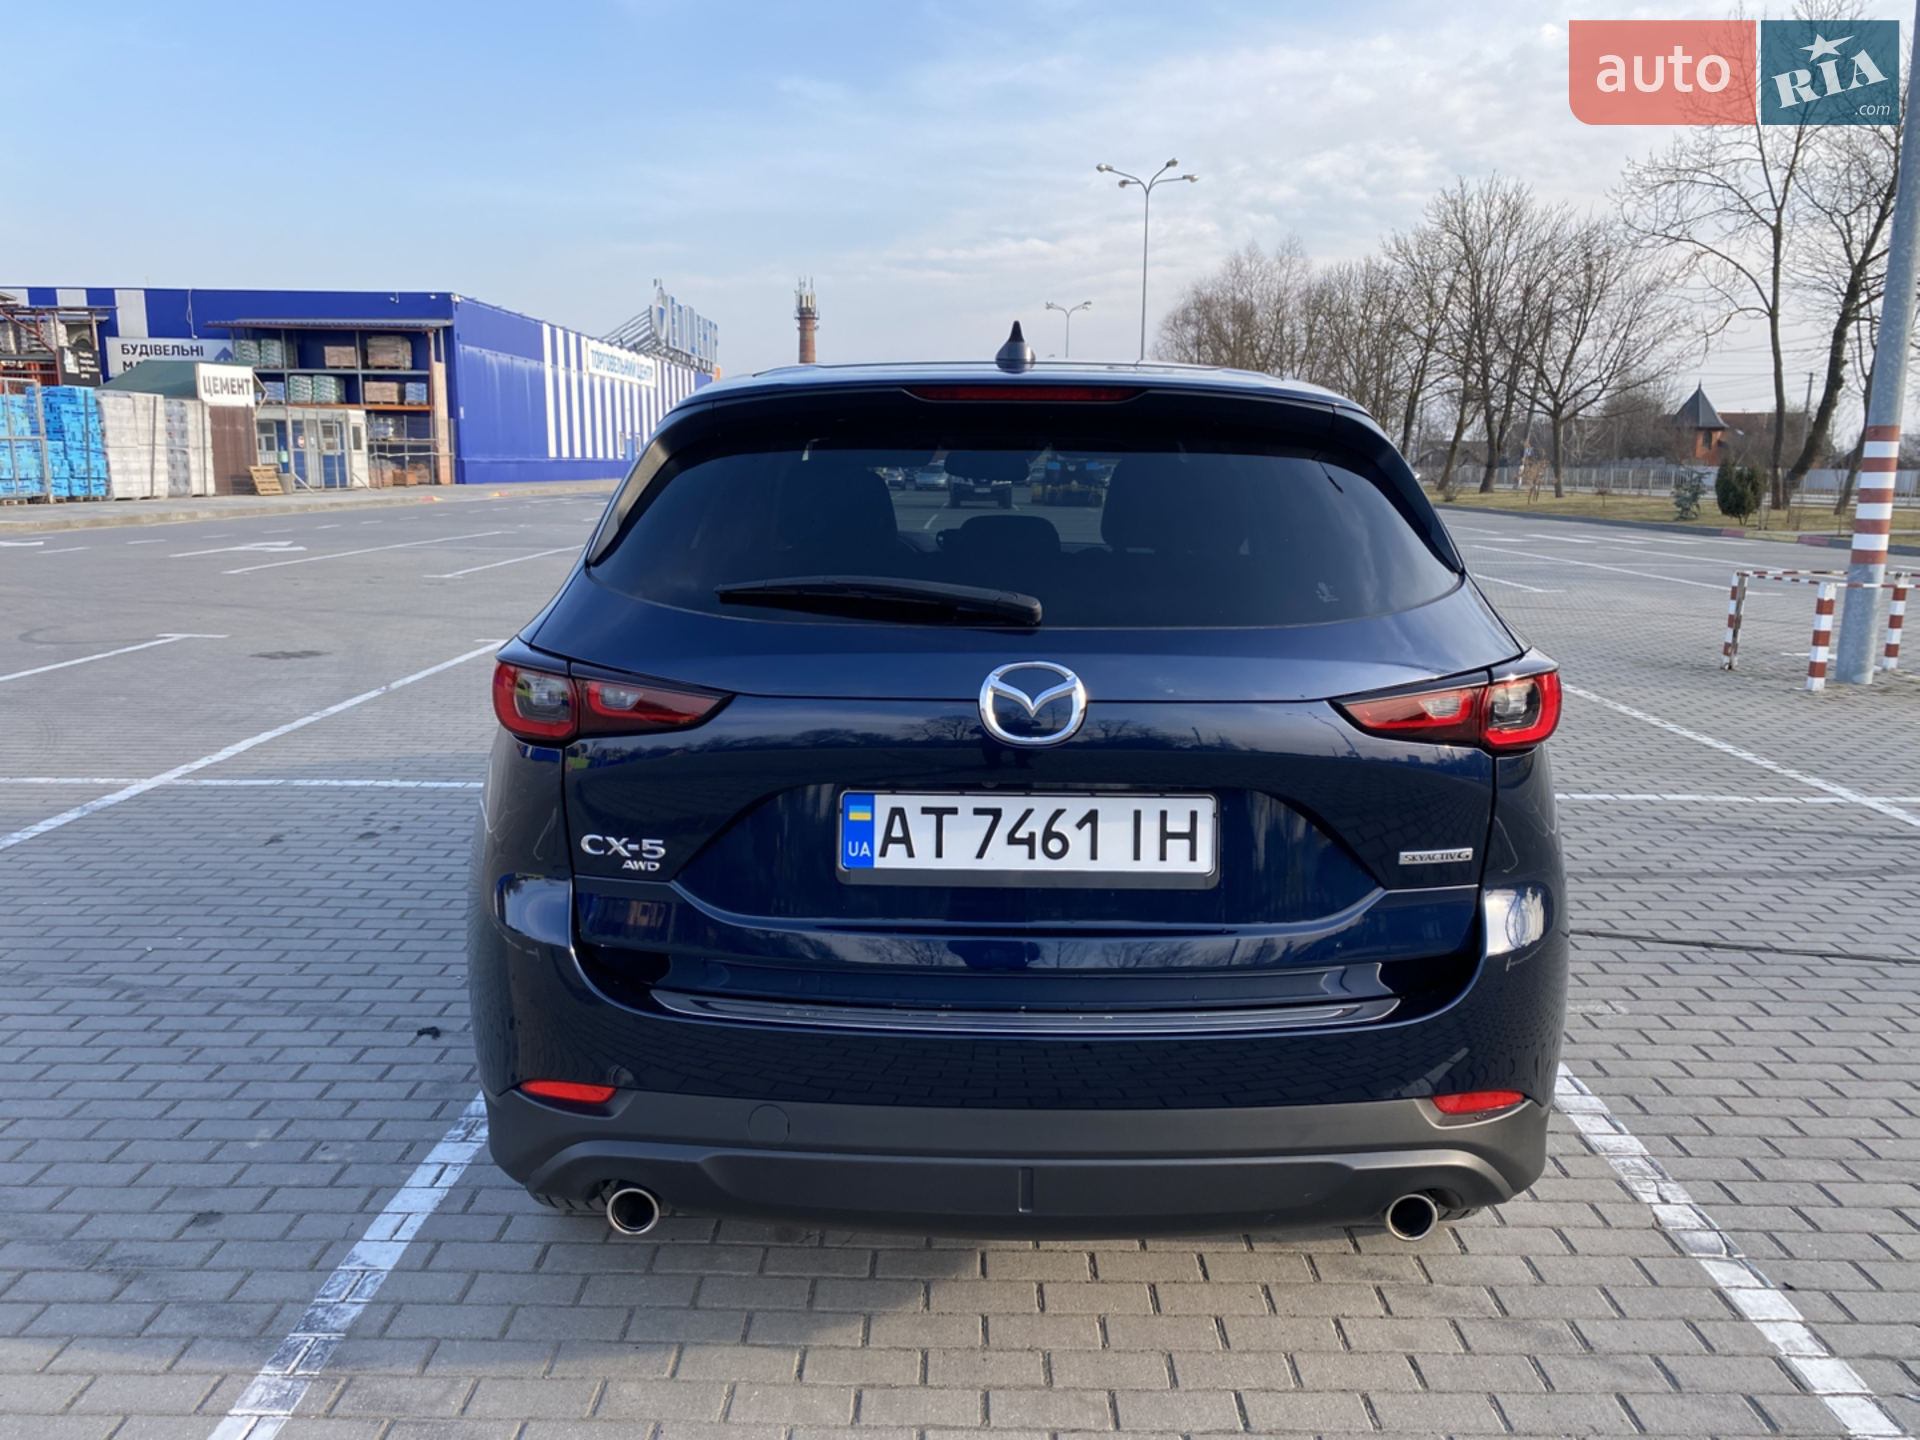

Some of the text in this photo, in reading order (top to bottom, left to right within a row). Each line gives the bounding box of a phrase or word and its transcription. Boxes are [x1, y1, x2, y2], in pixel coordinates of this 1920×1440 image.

[121, 343, 204, 357] БУДІВЕЛЬНІ
[203, 375, 251, 397] ЦЕМЕНТ
[878, 806, 1198, 862] AT 7461 IH
[580, 833, 666, 859] CX-5
[848, 841, 871, 857] UA
[621, 859, 660, 871] AWD
